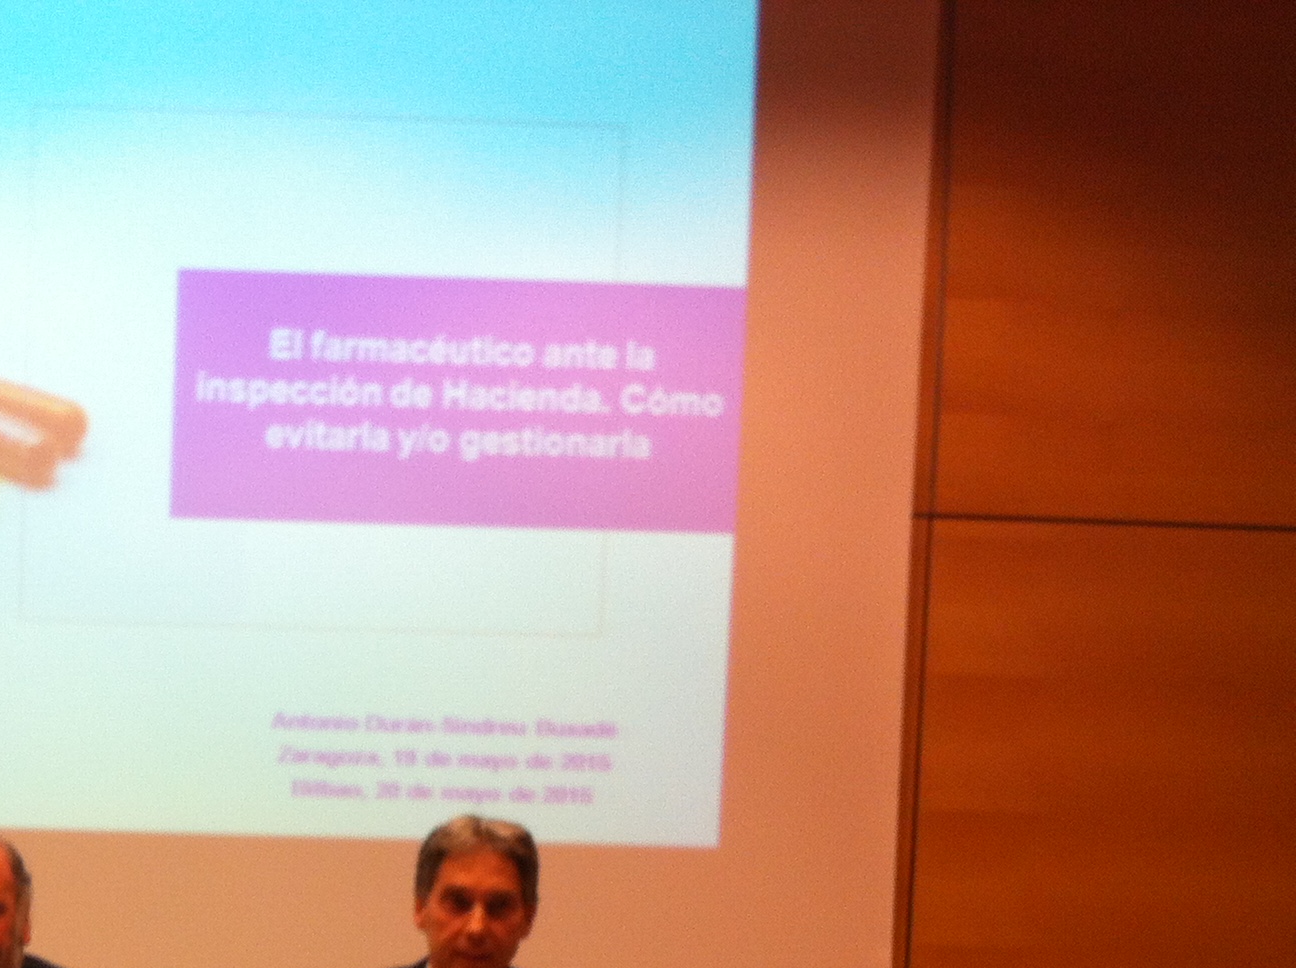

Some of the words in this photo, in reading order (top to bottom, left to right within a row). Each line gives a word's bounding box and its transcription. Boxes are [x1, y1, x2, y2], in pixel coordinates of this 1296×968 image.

[269, 327, 304, 361] El
[310, 328, 535, 368] farmacéutico
[544, 339, 618, 371] ante
[625, 341, 656, 372] la
[196, 371, 383, 413] inspección
[389, 379, 433, 409] de
[264, 420, 391, 453] evitarla
[459, 425, 652, 463] gestionarla
[425, 749, 452, 768] de
[526, 753, 554, 771] de
[407, 782, 434, 801] de
[508, 785, 537, 803] de
